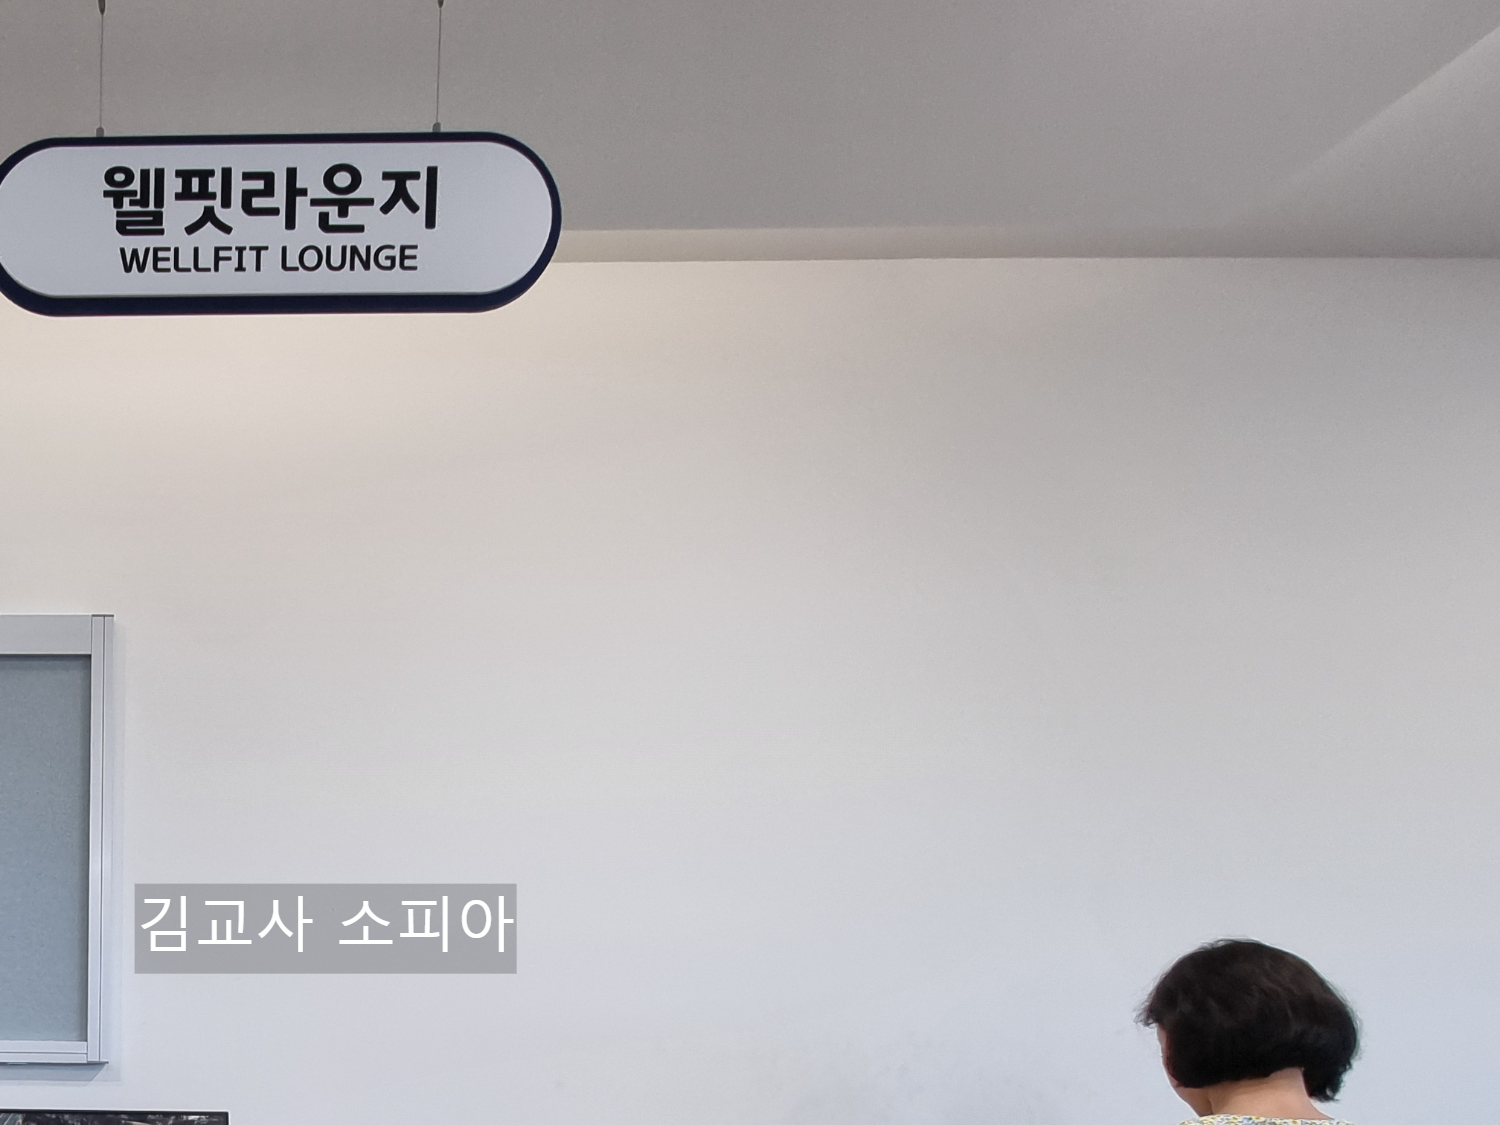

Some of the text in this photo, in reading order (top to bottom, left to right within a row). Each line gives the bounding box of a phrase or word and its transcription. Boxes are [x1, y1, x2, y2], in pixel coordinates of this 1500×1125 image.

[102, 163, 439, 237] 웰핏라운지
[119, 243, 418, 274] WELLFIT LOUNGE
